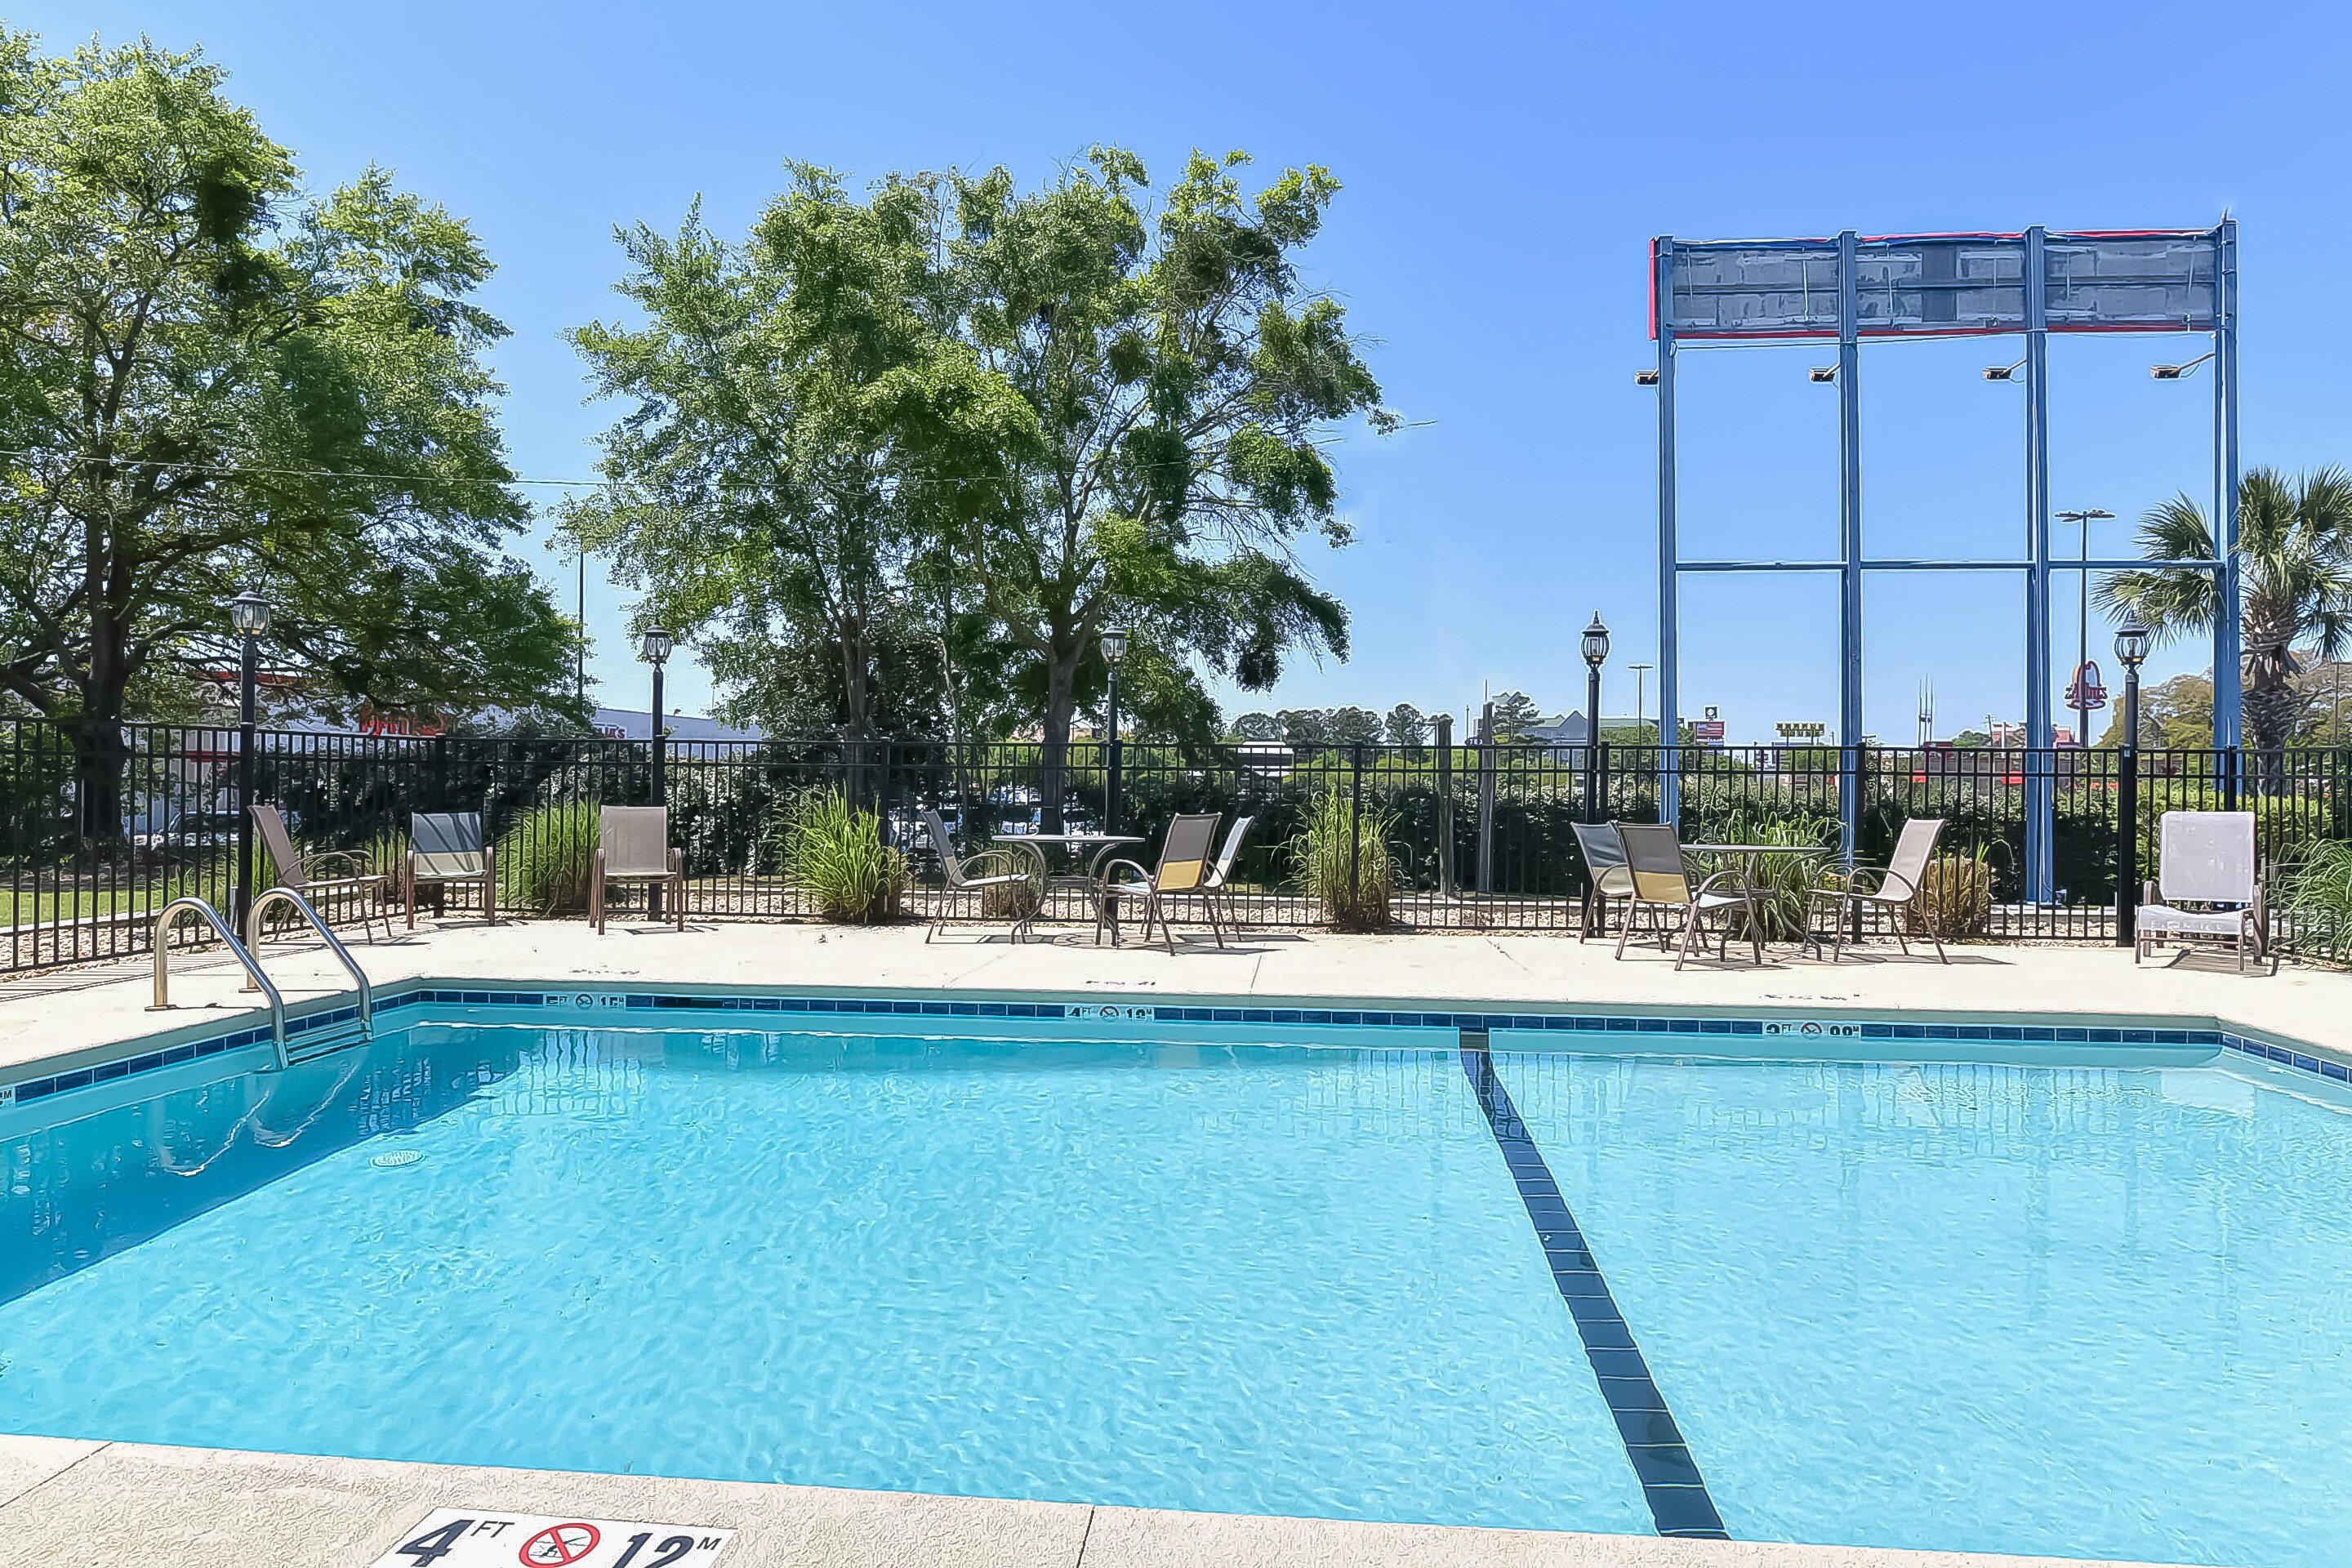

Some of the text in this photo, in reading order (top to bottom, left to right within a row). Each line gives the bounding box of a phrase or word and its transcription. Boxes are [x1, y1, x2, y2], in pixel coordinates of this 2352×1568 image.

[1068, 1007, 1080, 1017] 4
[1782, 1024, 1792, 1032] FT
[395, 1519, 475, 1567] 4
[470, 1521, 514, 1538] FT
[697, 1537, 722, 1550] M
